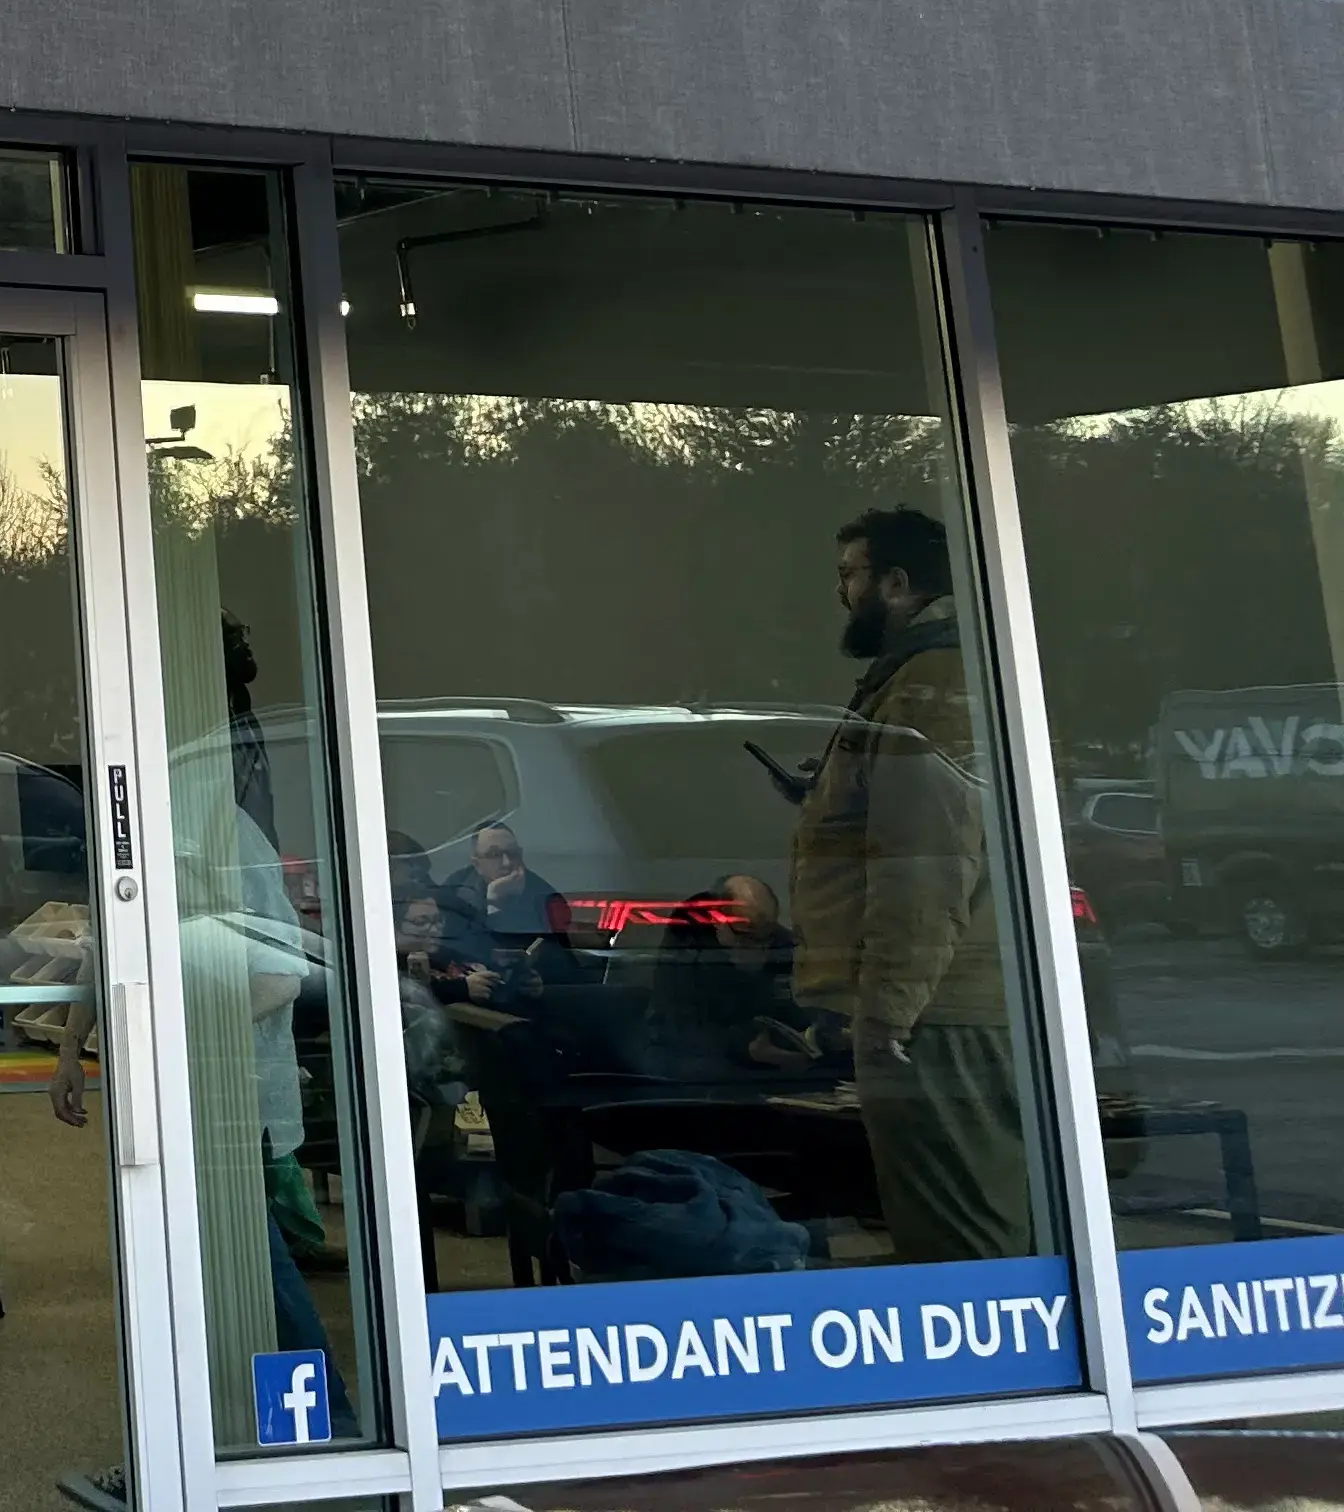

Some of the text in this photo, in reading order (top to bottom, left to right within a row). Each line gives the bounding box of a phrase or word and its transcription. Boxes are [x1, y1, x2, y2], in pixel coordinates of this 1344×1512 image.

[113, 768, 127, 838] PULL
[1143, 1273, 1344, 1345] SANITIZ
[432, 1295, 1068, 1399] ATTENDANT ON DUTY
